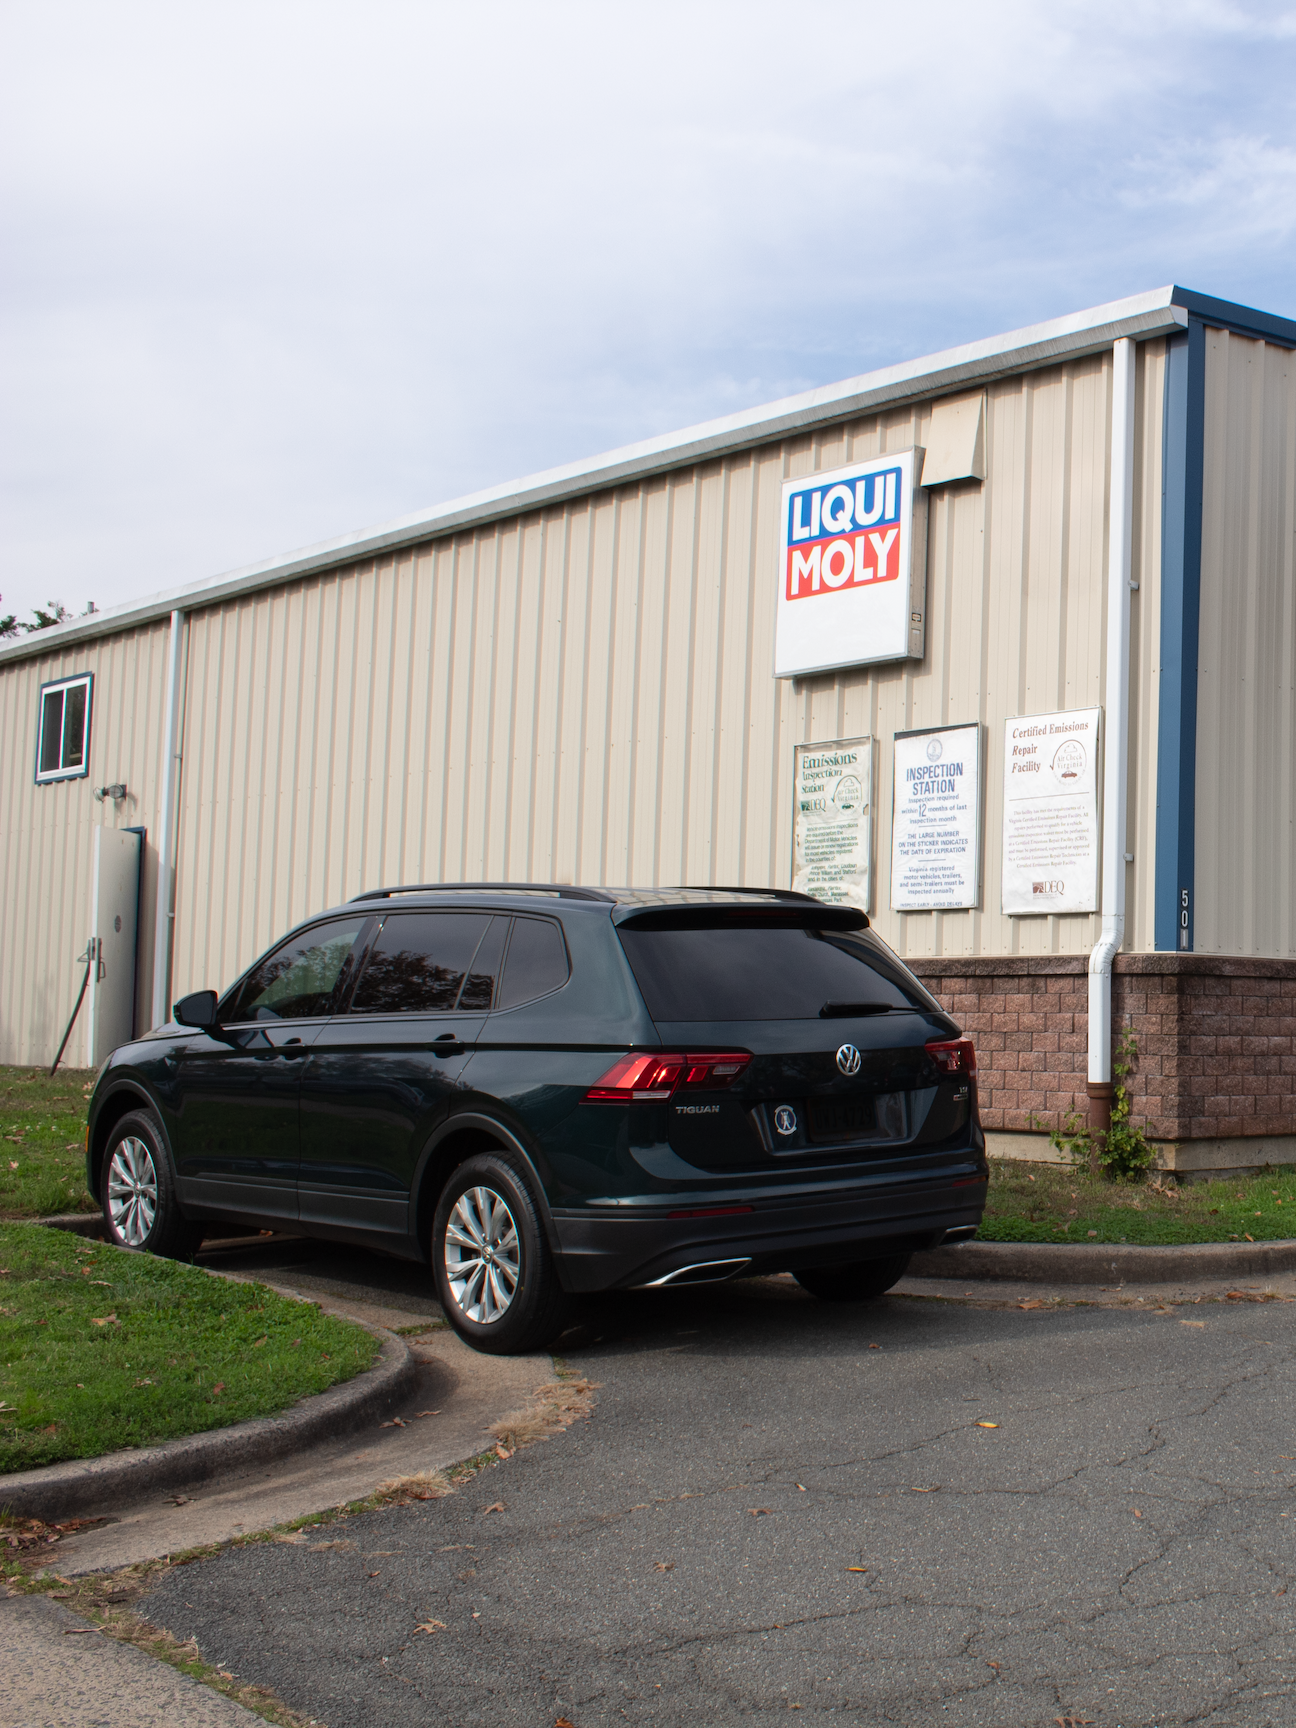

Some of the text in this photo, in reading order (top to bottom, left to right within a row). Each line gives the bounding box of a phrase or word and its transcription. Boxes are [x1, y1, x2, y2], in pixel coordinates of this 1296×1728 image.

[792, 472, 897, 541] LIQUI
[791, 528, 899, 596] MOLY
[1012, 721, 1089, 739] Certified Emissions
[1012, 743, 1038, 757] Repair
[803, 752, 858, 769] Emissions
[1012, 761, 1041, 773] Facility
[1057, 761, 1083, 770] Virginia
[803, 768, 843, 782] Inspection
[906, 762, 963, 782] INSPECTION
[802, 783, 825, 794] Station
[912, 779, 955, 796] STATION
[936, 793, 959, 801] required
[919, 803, 927, 817] 12
[936, 830, 960, 838] NUMBER
[934, 846, 966, 854] EXPIRATION
[1044, 880, 1064, 895] DEQ
[675, 1105, 720, 1114] TIGUAN
